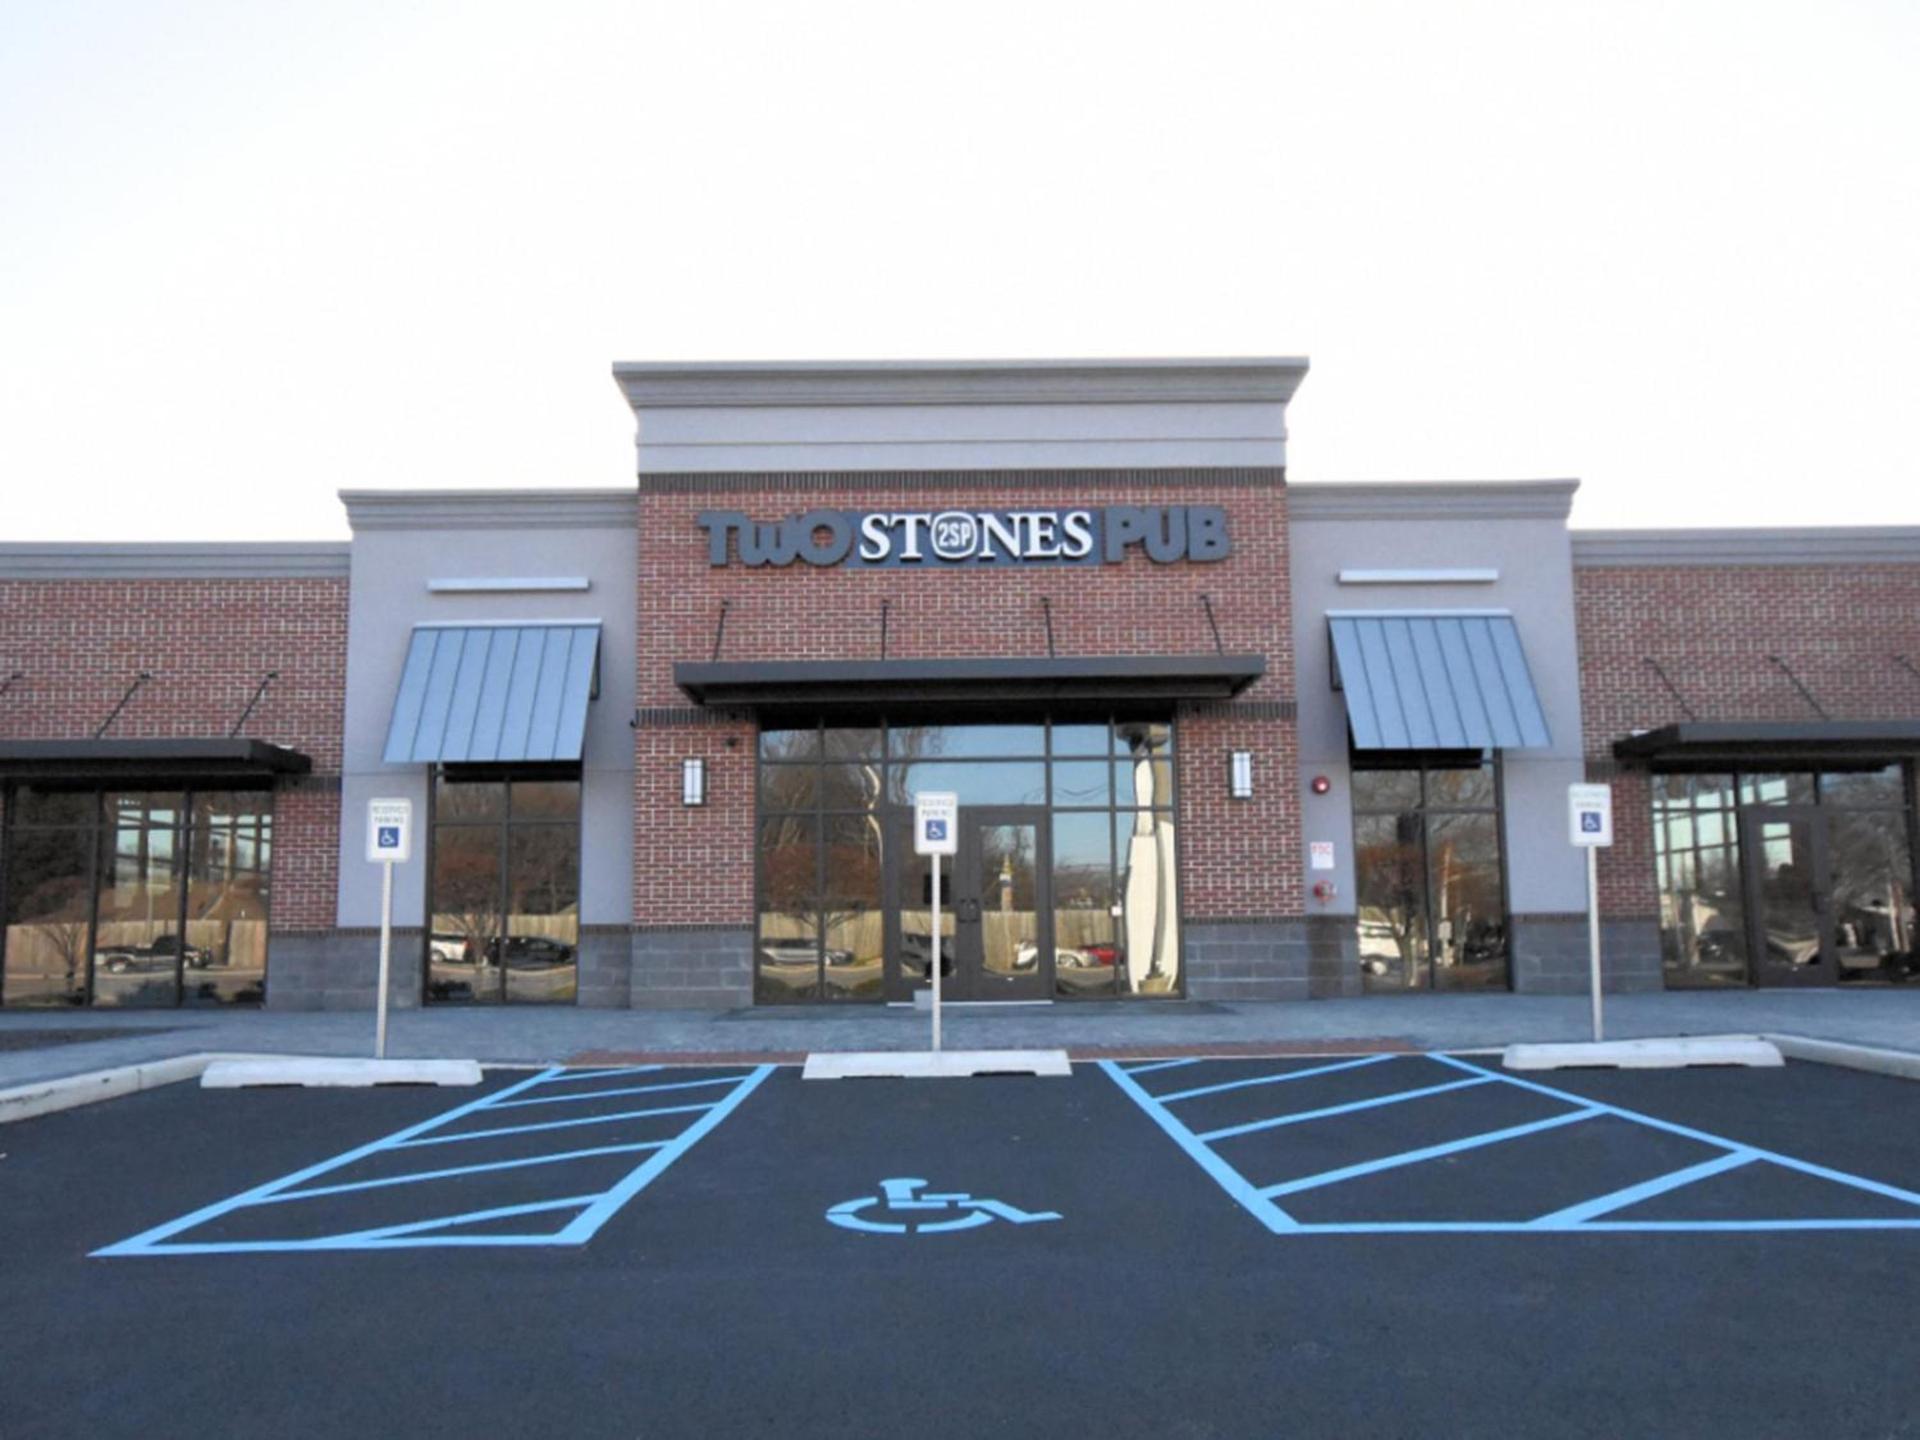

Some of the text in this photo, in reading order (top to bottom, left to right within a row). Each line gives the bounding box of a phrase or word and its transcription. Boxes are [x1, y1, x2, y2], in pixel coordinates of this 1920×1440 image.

[859, 511, 1095, 560] STONES
[1103, 505, 1232, 565] PUB
[938, 521, 971, 547] 2SP
